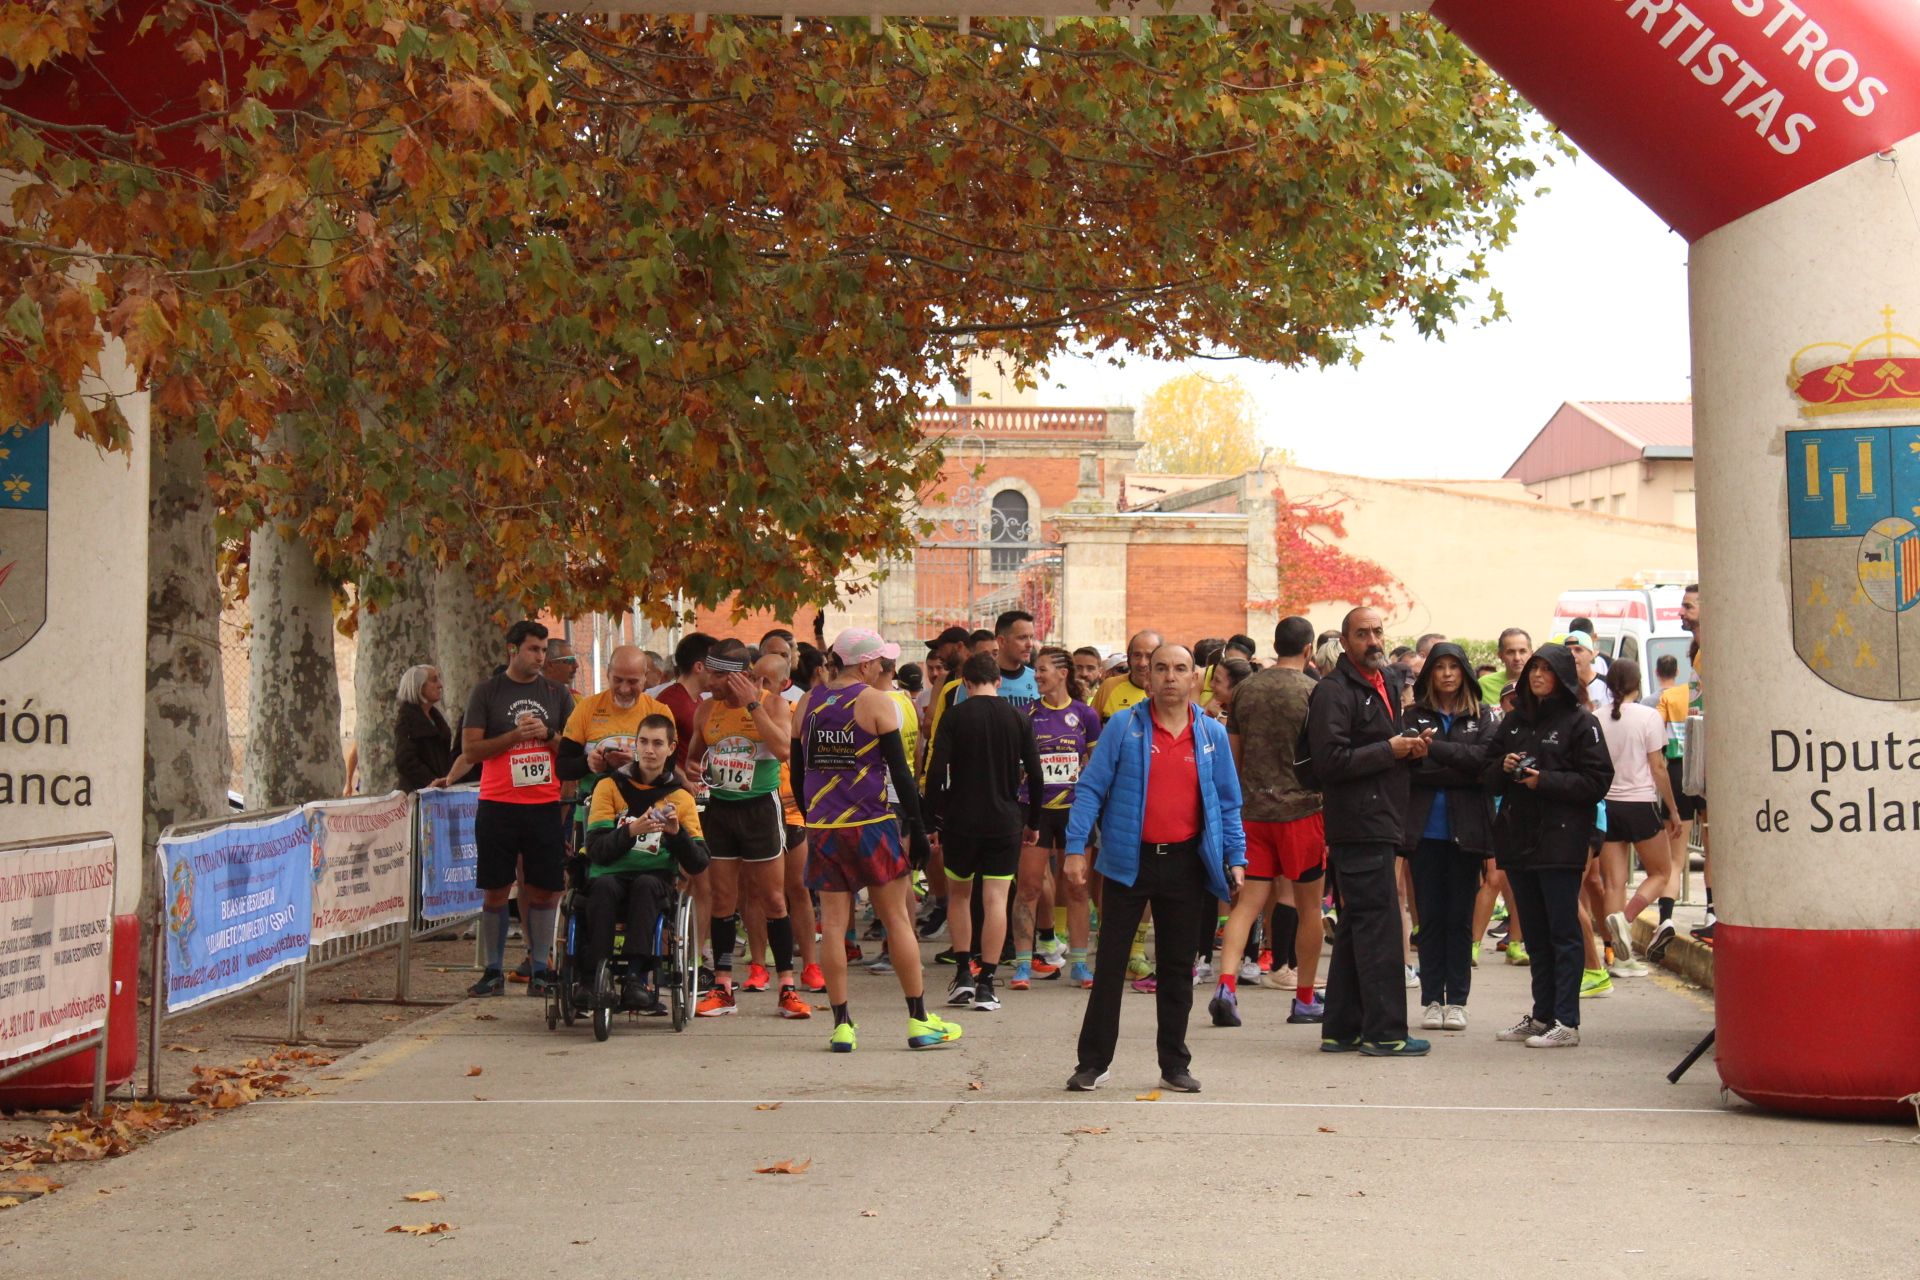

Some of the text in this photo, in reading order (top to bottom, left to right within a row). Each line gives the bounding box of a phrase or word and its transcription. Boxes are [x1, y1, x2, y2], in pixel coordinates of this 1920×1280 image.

[1617, 0, 1817, 155] RTISTAS
[817, 730, 855, 744] PRIM
[522, 764, 545, 778] 189
[719, 767, 743, 783] 116
[1046, 764, 1069, 776] 141
[1756, 787, 1920, 833] de Sala
